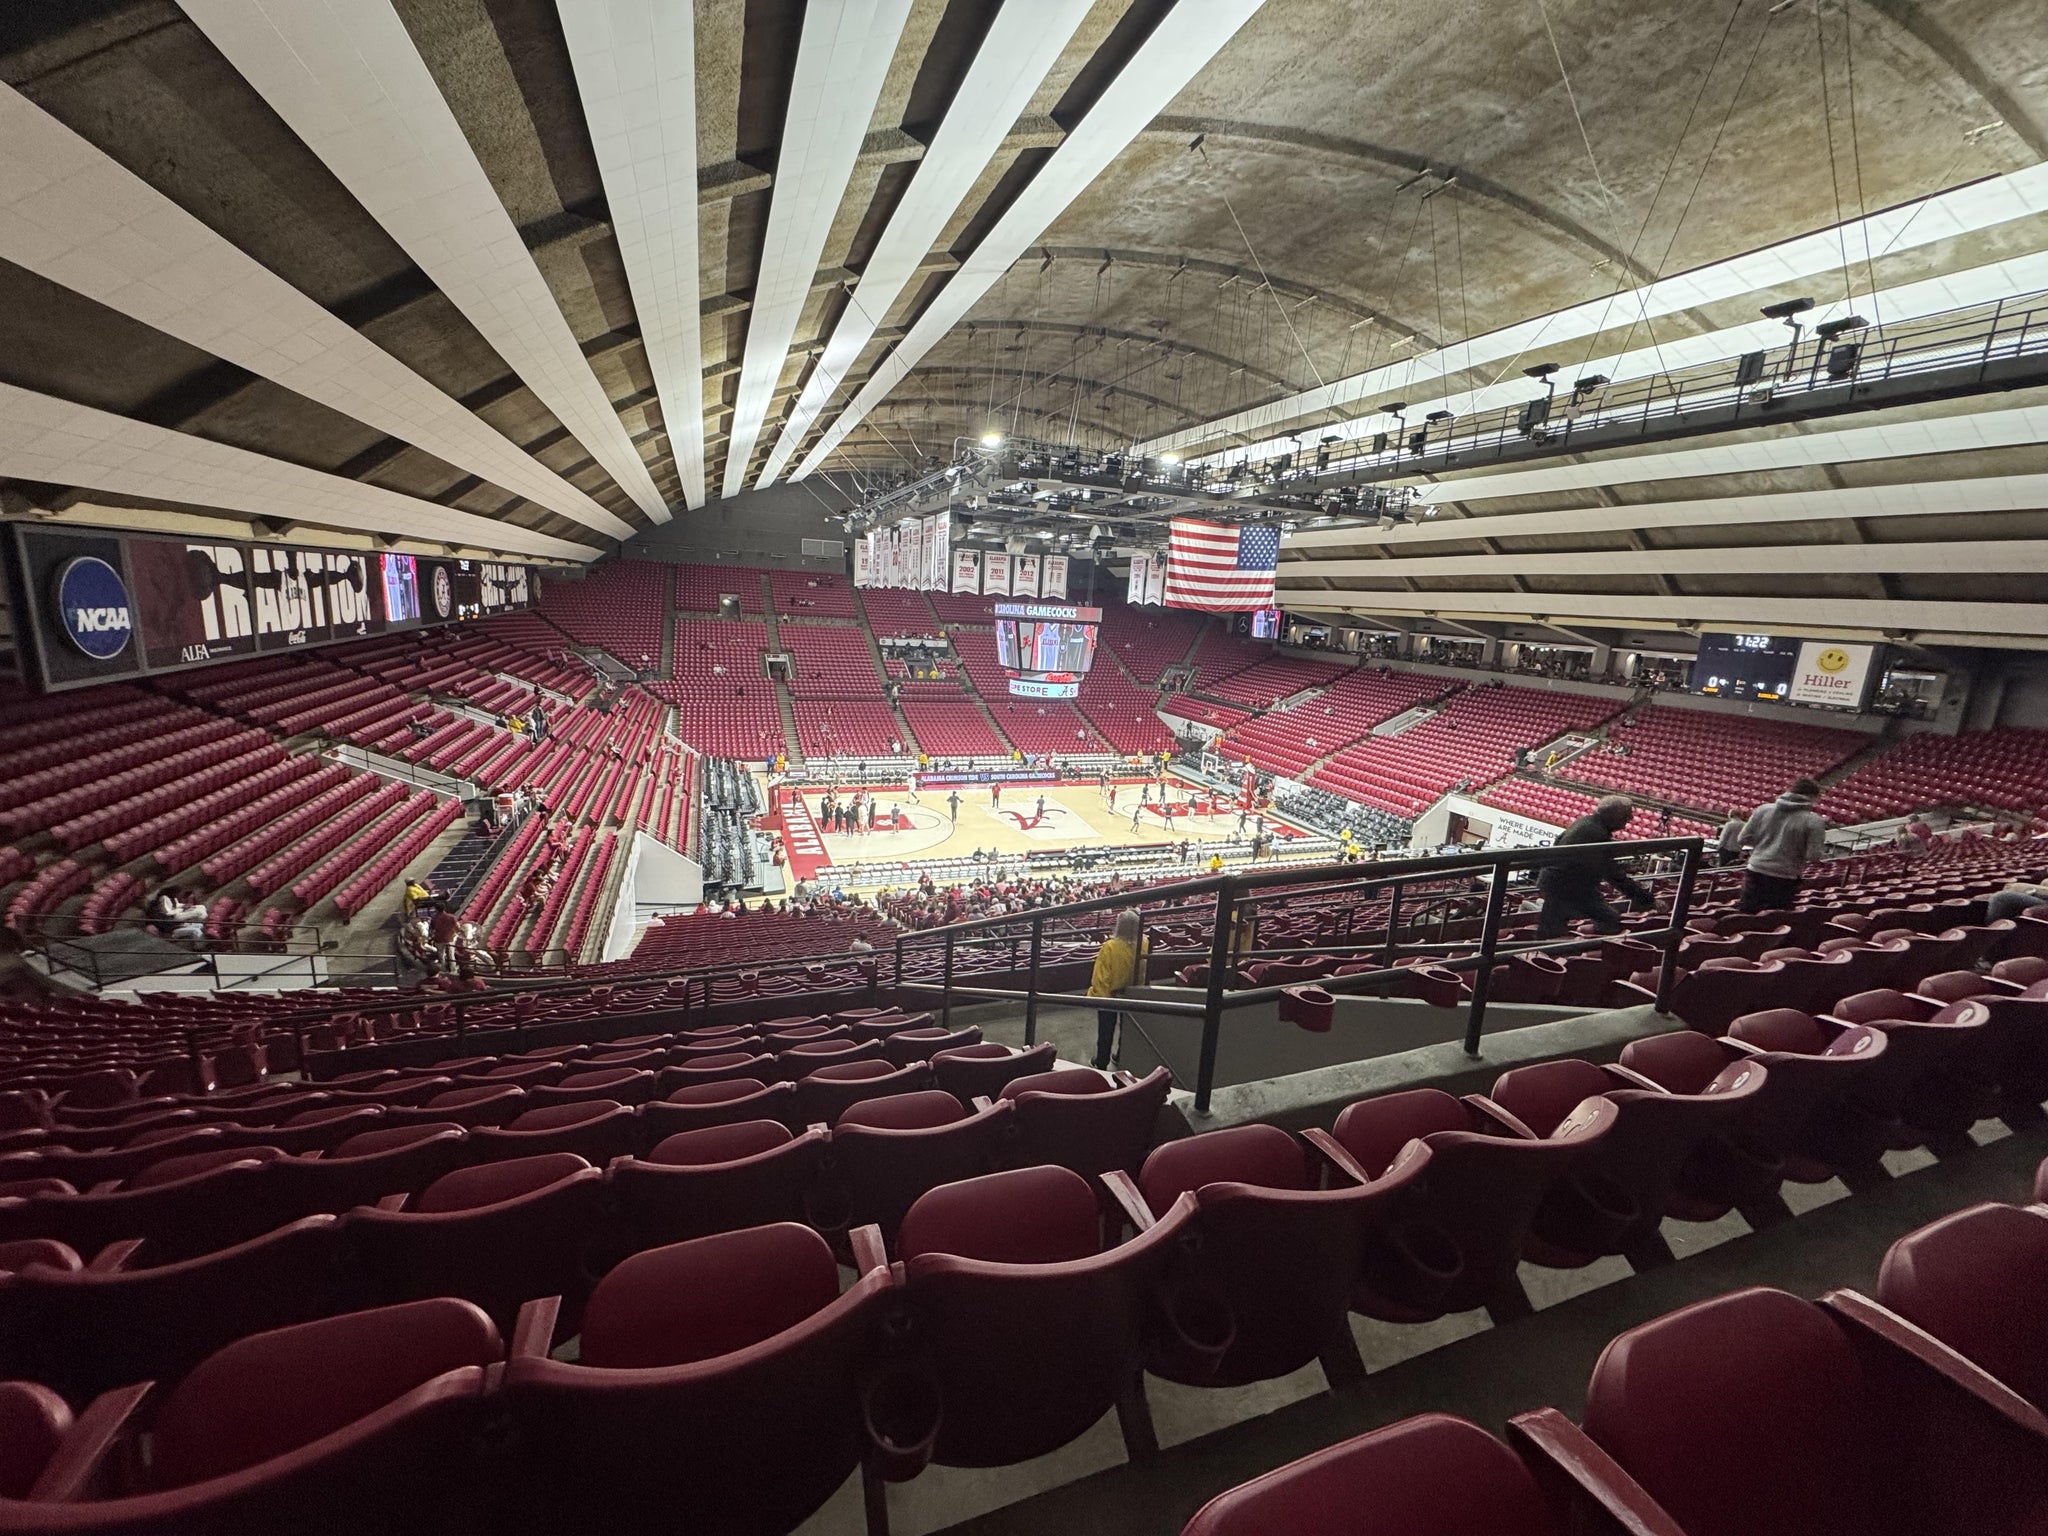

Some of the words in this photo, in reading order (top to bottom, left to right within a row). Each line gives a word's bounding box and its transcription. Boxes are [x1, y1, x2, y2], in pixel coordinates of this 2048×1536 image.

[1026, 605, 1077, 618] GAMECOCKS
[77, 607, 131, 633] NCAA
[181, 644, 210, 663] ALFA
[1708, 676, 1718, 687] 0
[1803, 674, 1852, 689] Hiller
[1022, 685, 1048, 696] STORE
[1776, 683, 1787, 695] 0
[782, 802, 824, 855] ALABAMA
[1500, 817, 1524, 830] WHERE
[1498, 824, 1512, 832] ARE
[1512, 829, 1534, 839] MADE
